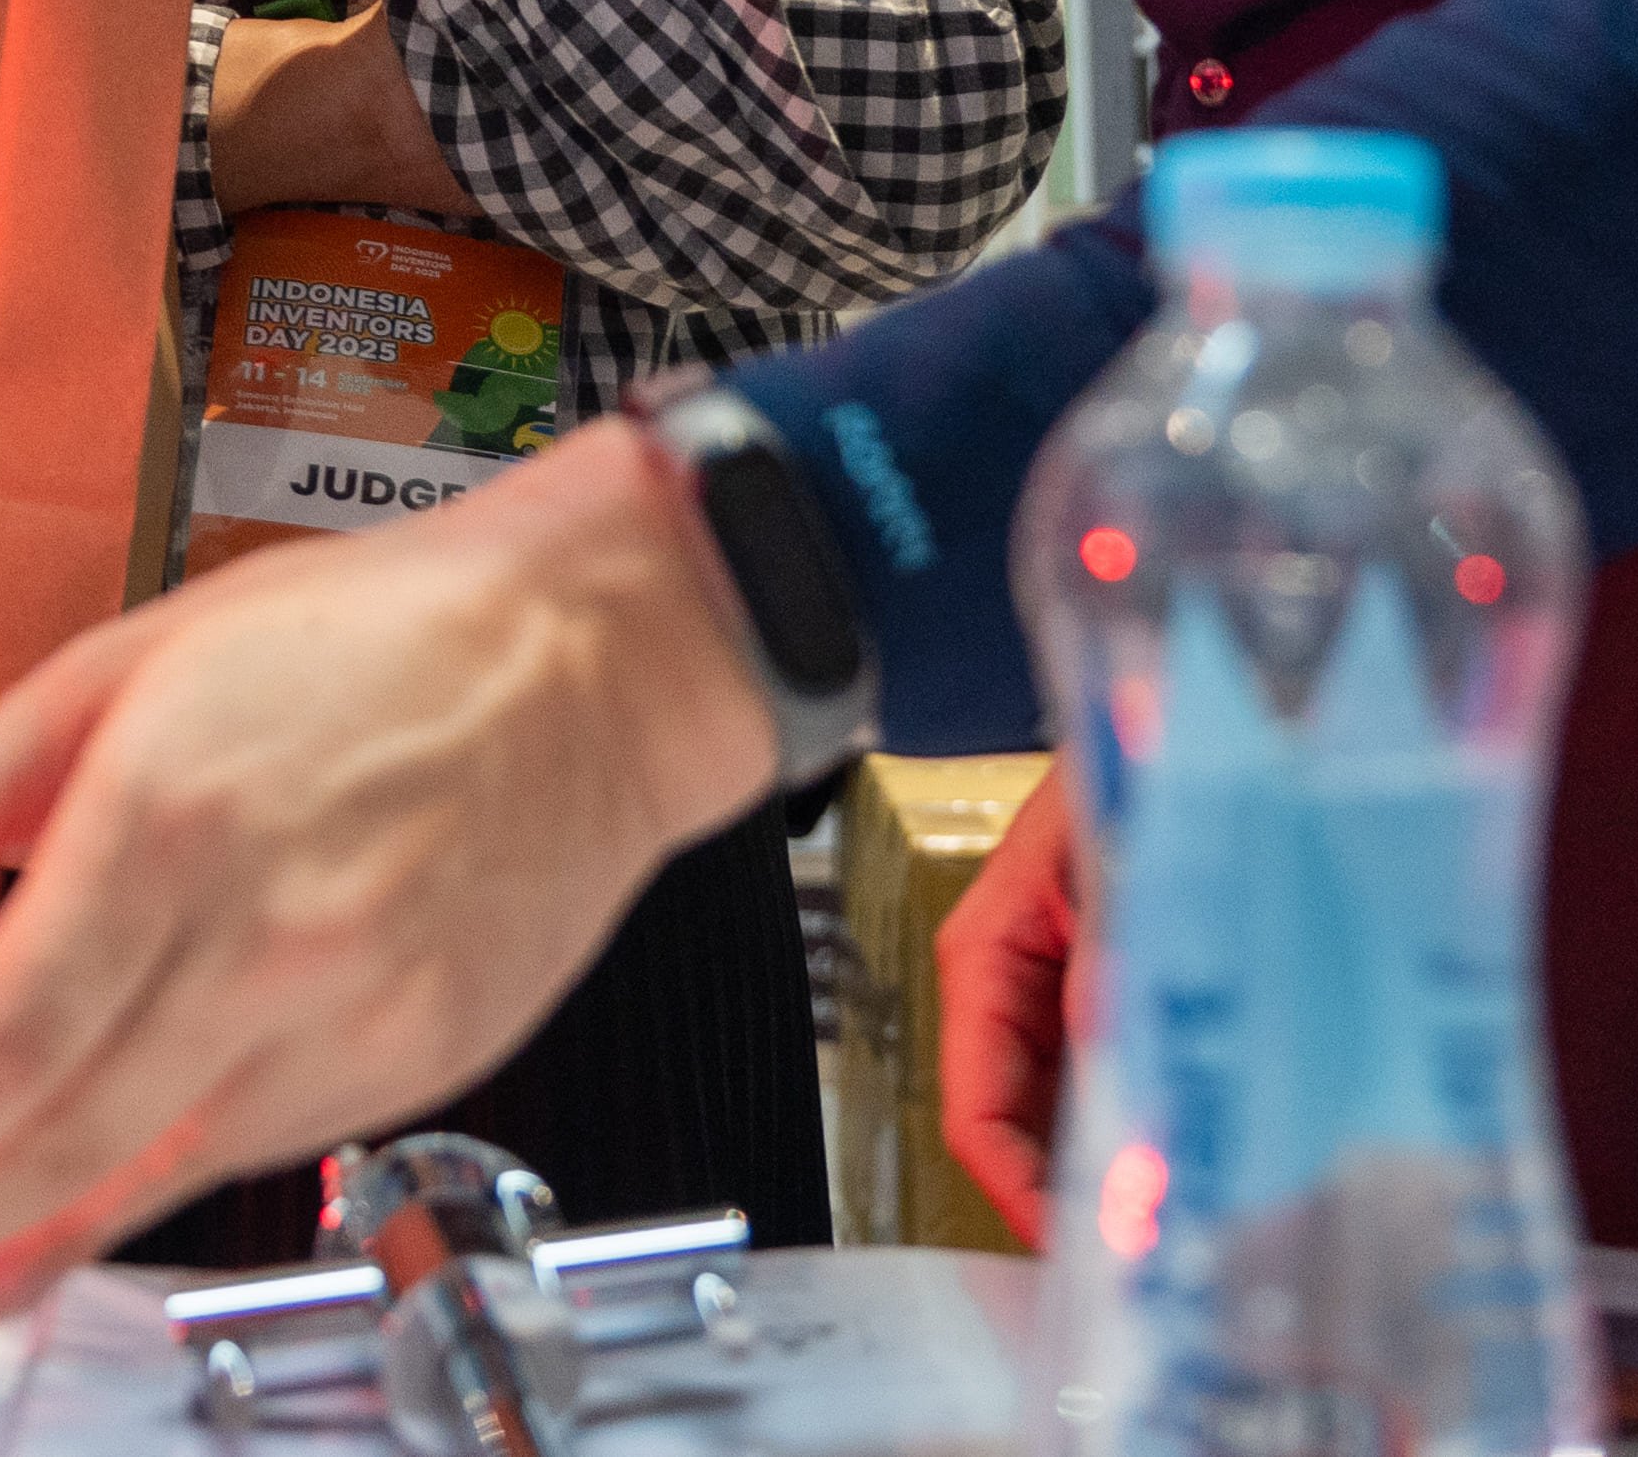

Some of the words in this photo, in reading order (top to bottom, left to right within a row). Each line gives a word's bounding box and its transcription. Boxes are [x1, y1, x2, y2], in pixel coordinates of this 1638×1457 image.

[251, 277, 430, 320] INDONESIA
[248, 300, 435, 345] INVENTORS
[245, 324, 311, 351] DAY
[317, 332, 399, 364] 2025
[241, 360, 266, 383] 11
[296, 366, 328, 389] 14
